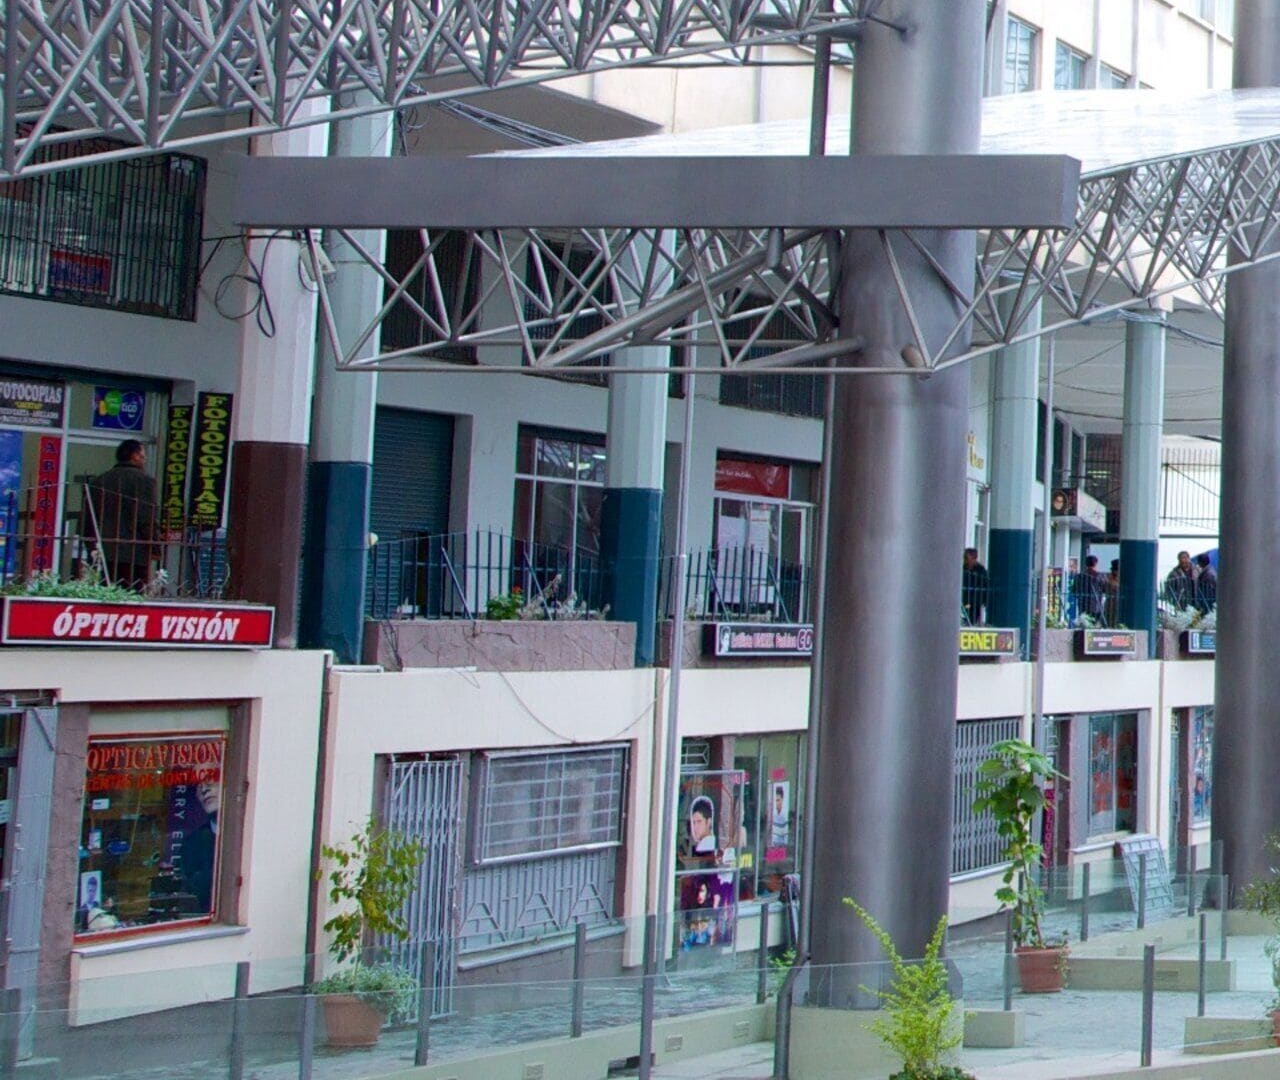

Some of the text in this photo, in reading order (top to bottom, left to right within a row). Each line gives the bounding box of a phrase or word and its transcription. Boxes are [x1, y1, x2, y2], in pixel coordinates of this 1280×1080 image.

[164, 407, 189, 518] FOTOCOPIAS
[194, 395, 227, 514] FOTOCOPIAS
[53, 605, 240, 641] ÓPTICA VISIÓN
[960, 631, 998, 650] ERNET
